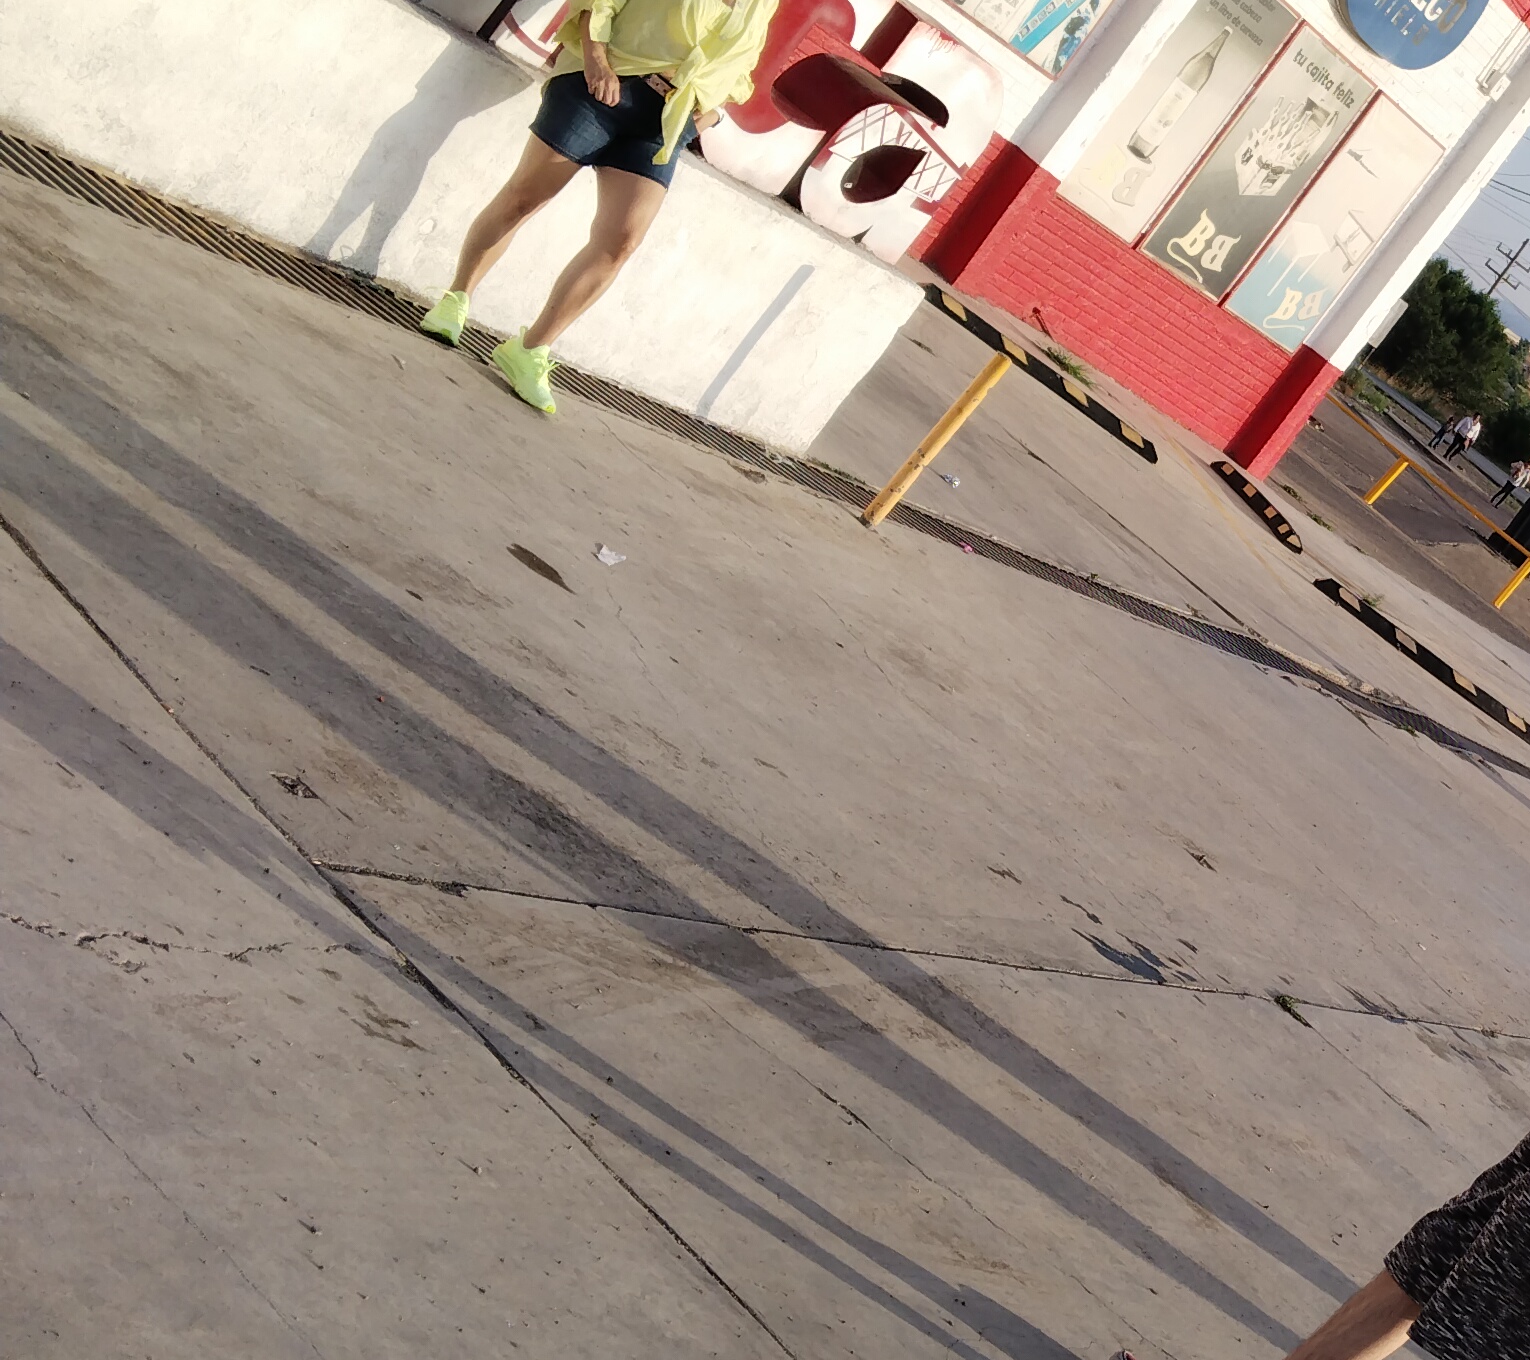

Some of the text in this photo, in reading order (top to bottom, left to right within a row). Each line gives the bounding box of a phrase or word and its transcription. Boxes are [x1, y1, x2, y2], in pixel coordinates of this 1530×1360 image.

[1217, 1, 1233, 21] litro
[1231, 14, 1242, 28] de
[1240, 24, 1265, 47] cerveza
[1239, 1, 1263, 24] cabeza
[1292, 47, 1356, 110] tu cajita feliz
